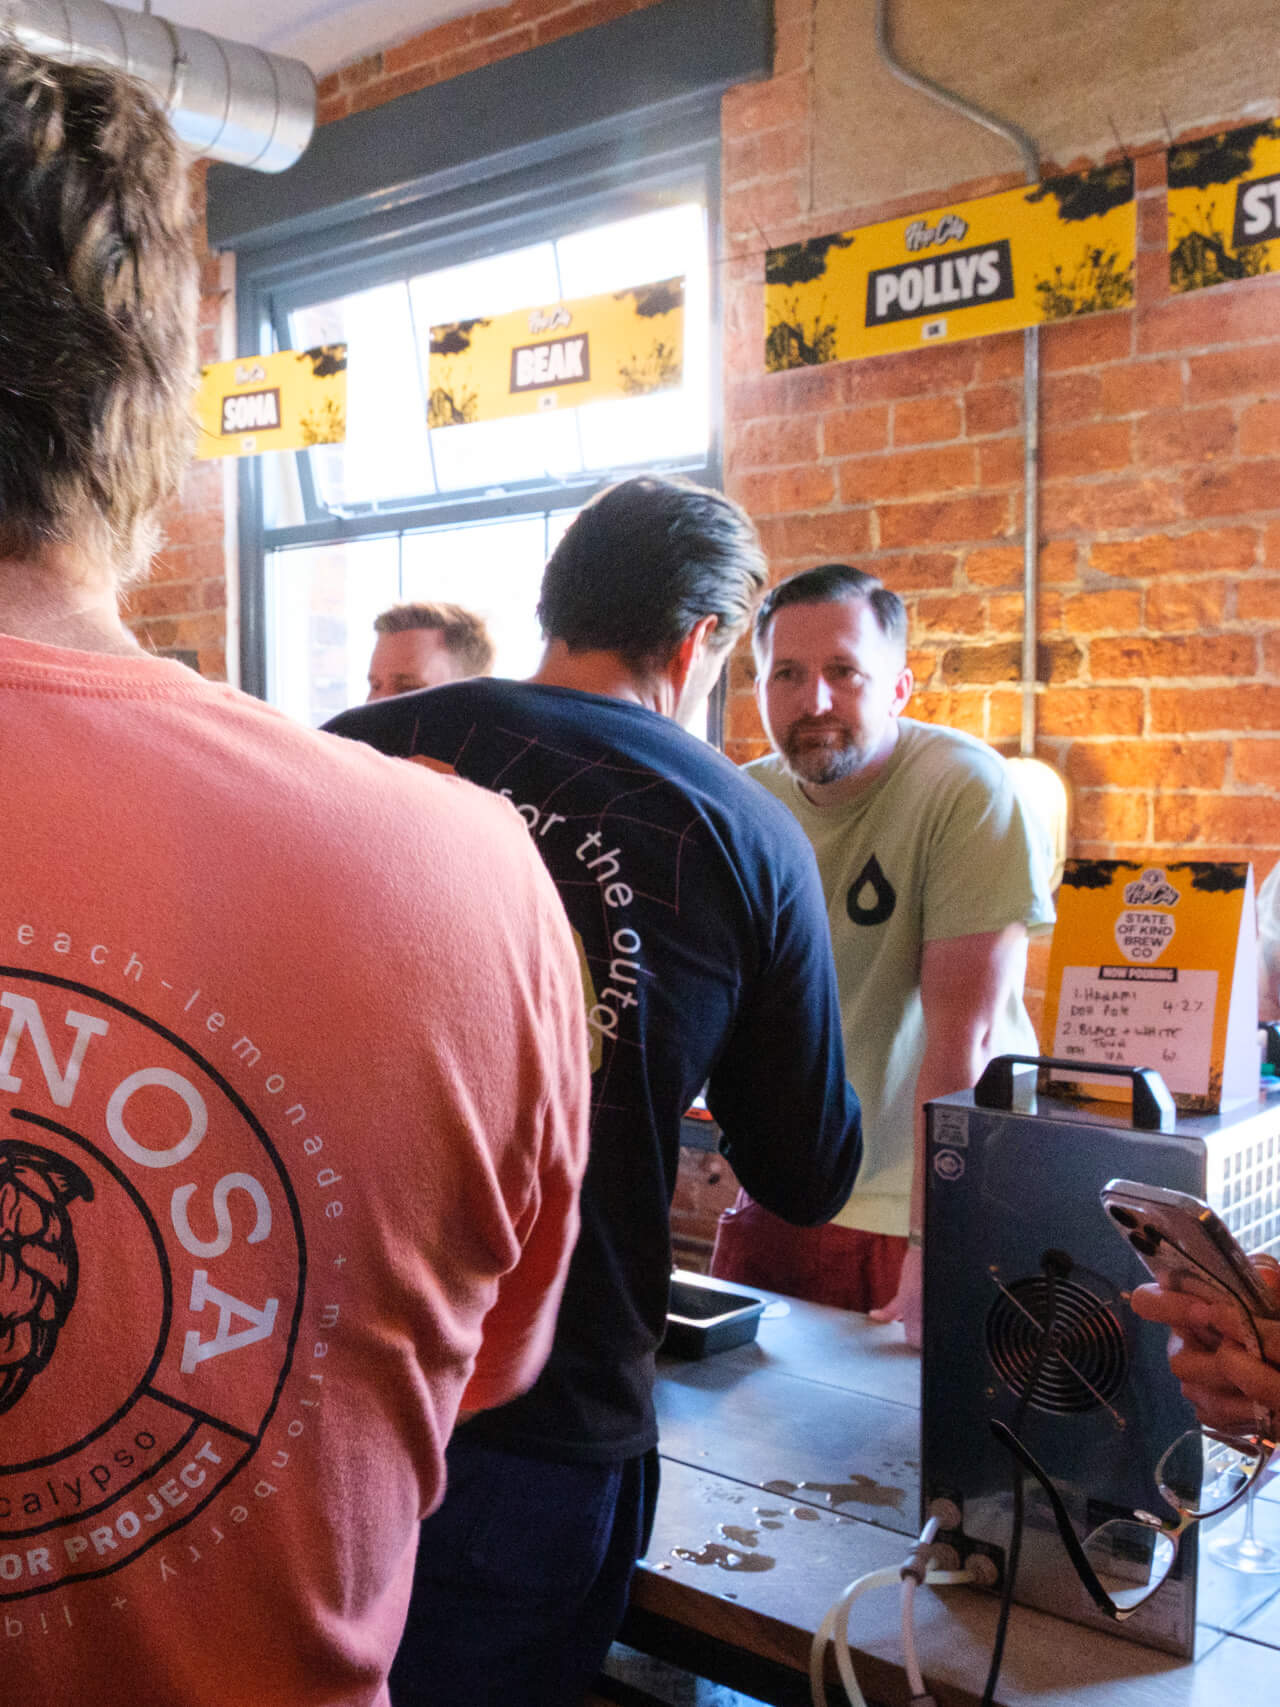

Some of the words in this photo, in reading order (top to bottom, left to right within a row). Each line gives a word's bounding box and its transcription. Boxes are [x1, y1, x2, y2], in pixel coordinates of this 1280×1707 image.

[876, 250, 1001, 317] POLLYS
[516, 339, 584, 387] BEAK
[224, 392, 278, 430] SOMA
[575, 831, 634, 908] the
[1118, 924, 1136, 934] OF
[1140, 926, 1173, 936] KIND
[1126, 913, 1168, 924] STATE
[1124, 936, 1163, 947] BREW
[1132, 948, 1153, 958] CO
[159, 1303, 340, 1582] marionberry
[63, 1441, 222, 1563] PROJECT
